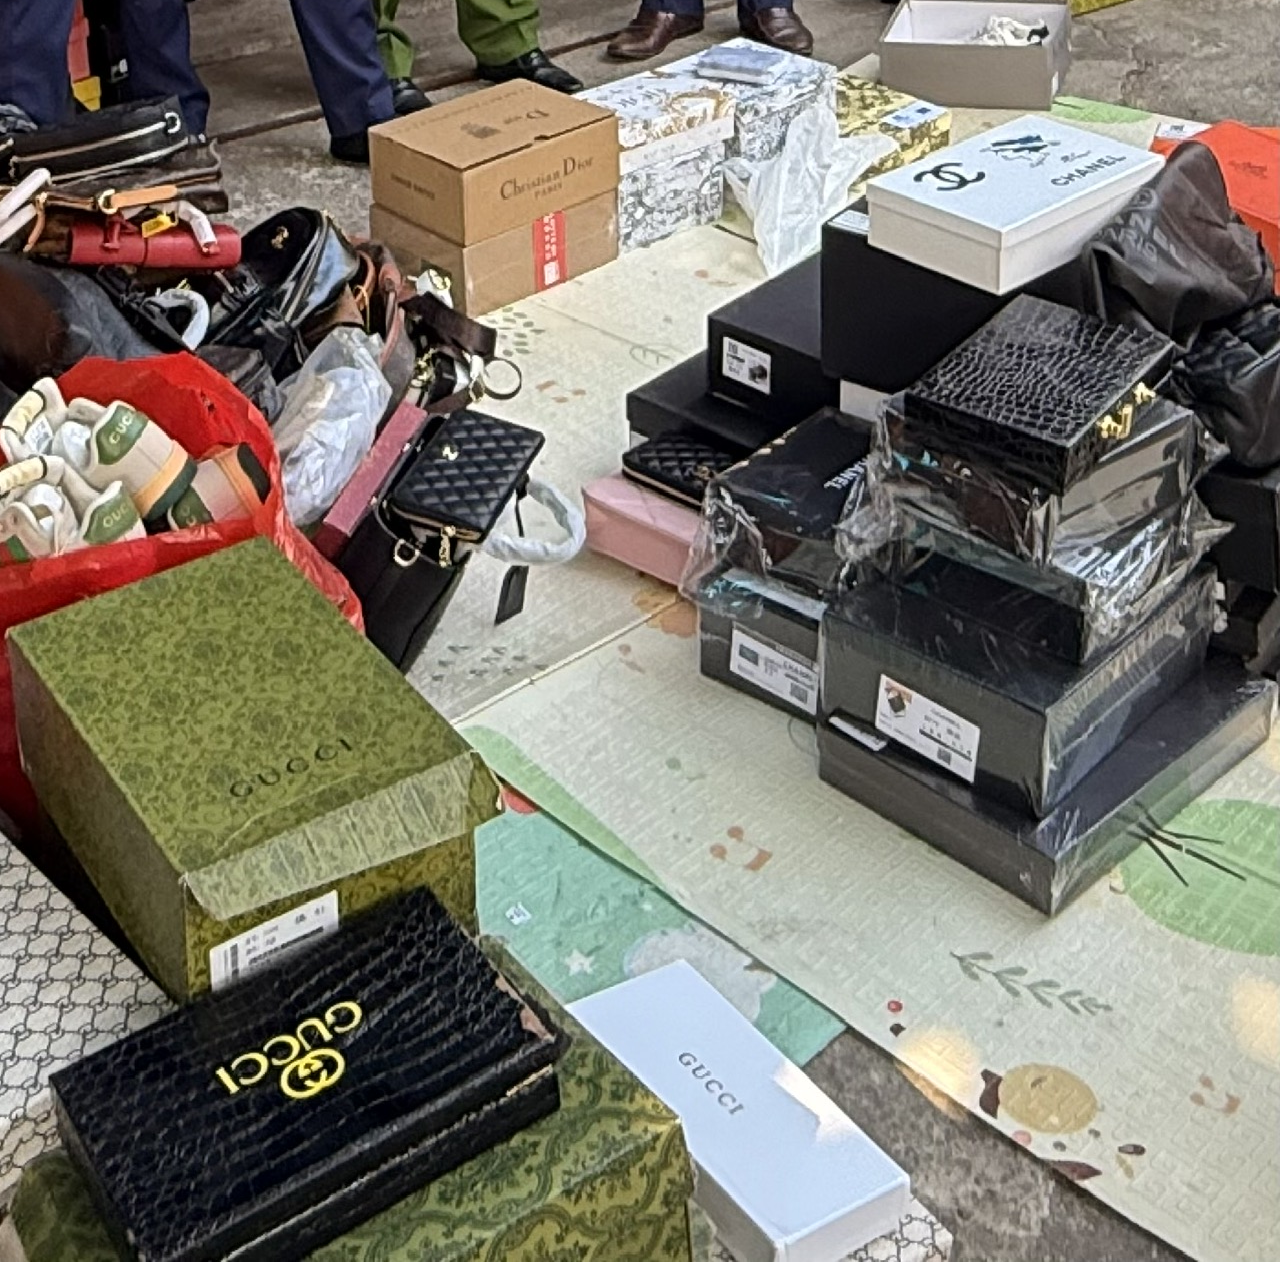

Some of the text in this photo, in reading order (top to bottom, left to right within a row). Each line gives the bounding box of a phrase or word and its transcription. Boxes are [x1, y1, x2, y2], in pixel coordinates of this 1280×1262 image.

[1051, 154, 1126, 187] CHANEL
[230, 739, 353, 798] GUCCI
[215, 1001, 363, 1094] GUCCI
[678, 1052, 744, 1115] GUCCI
